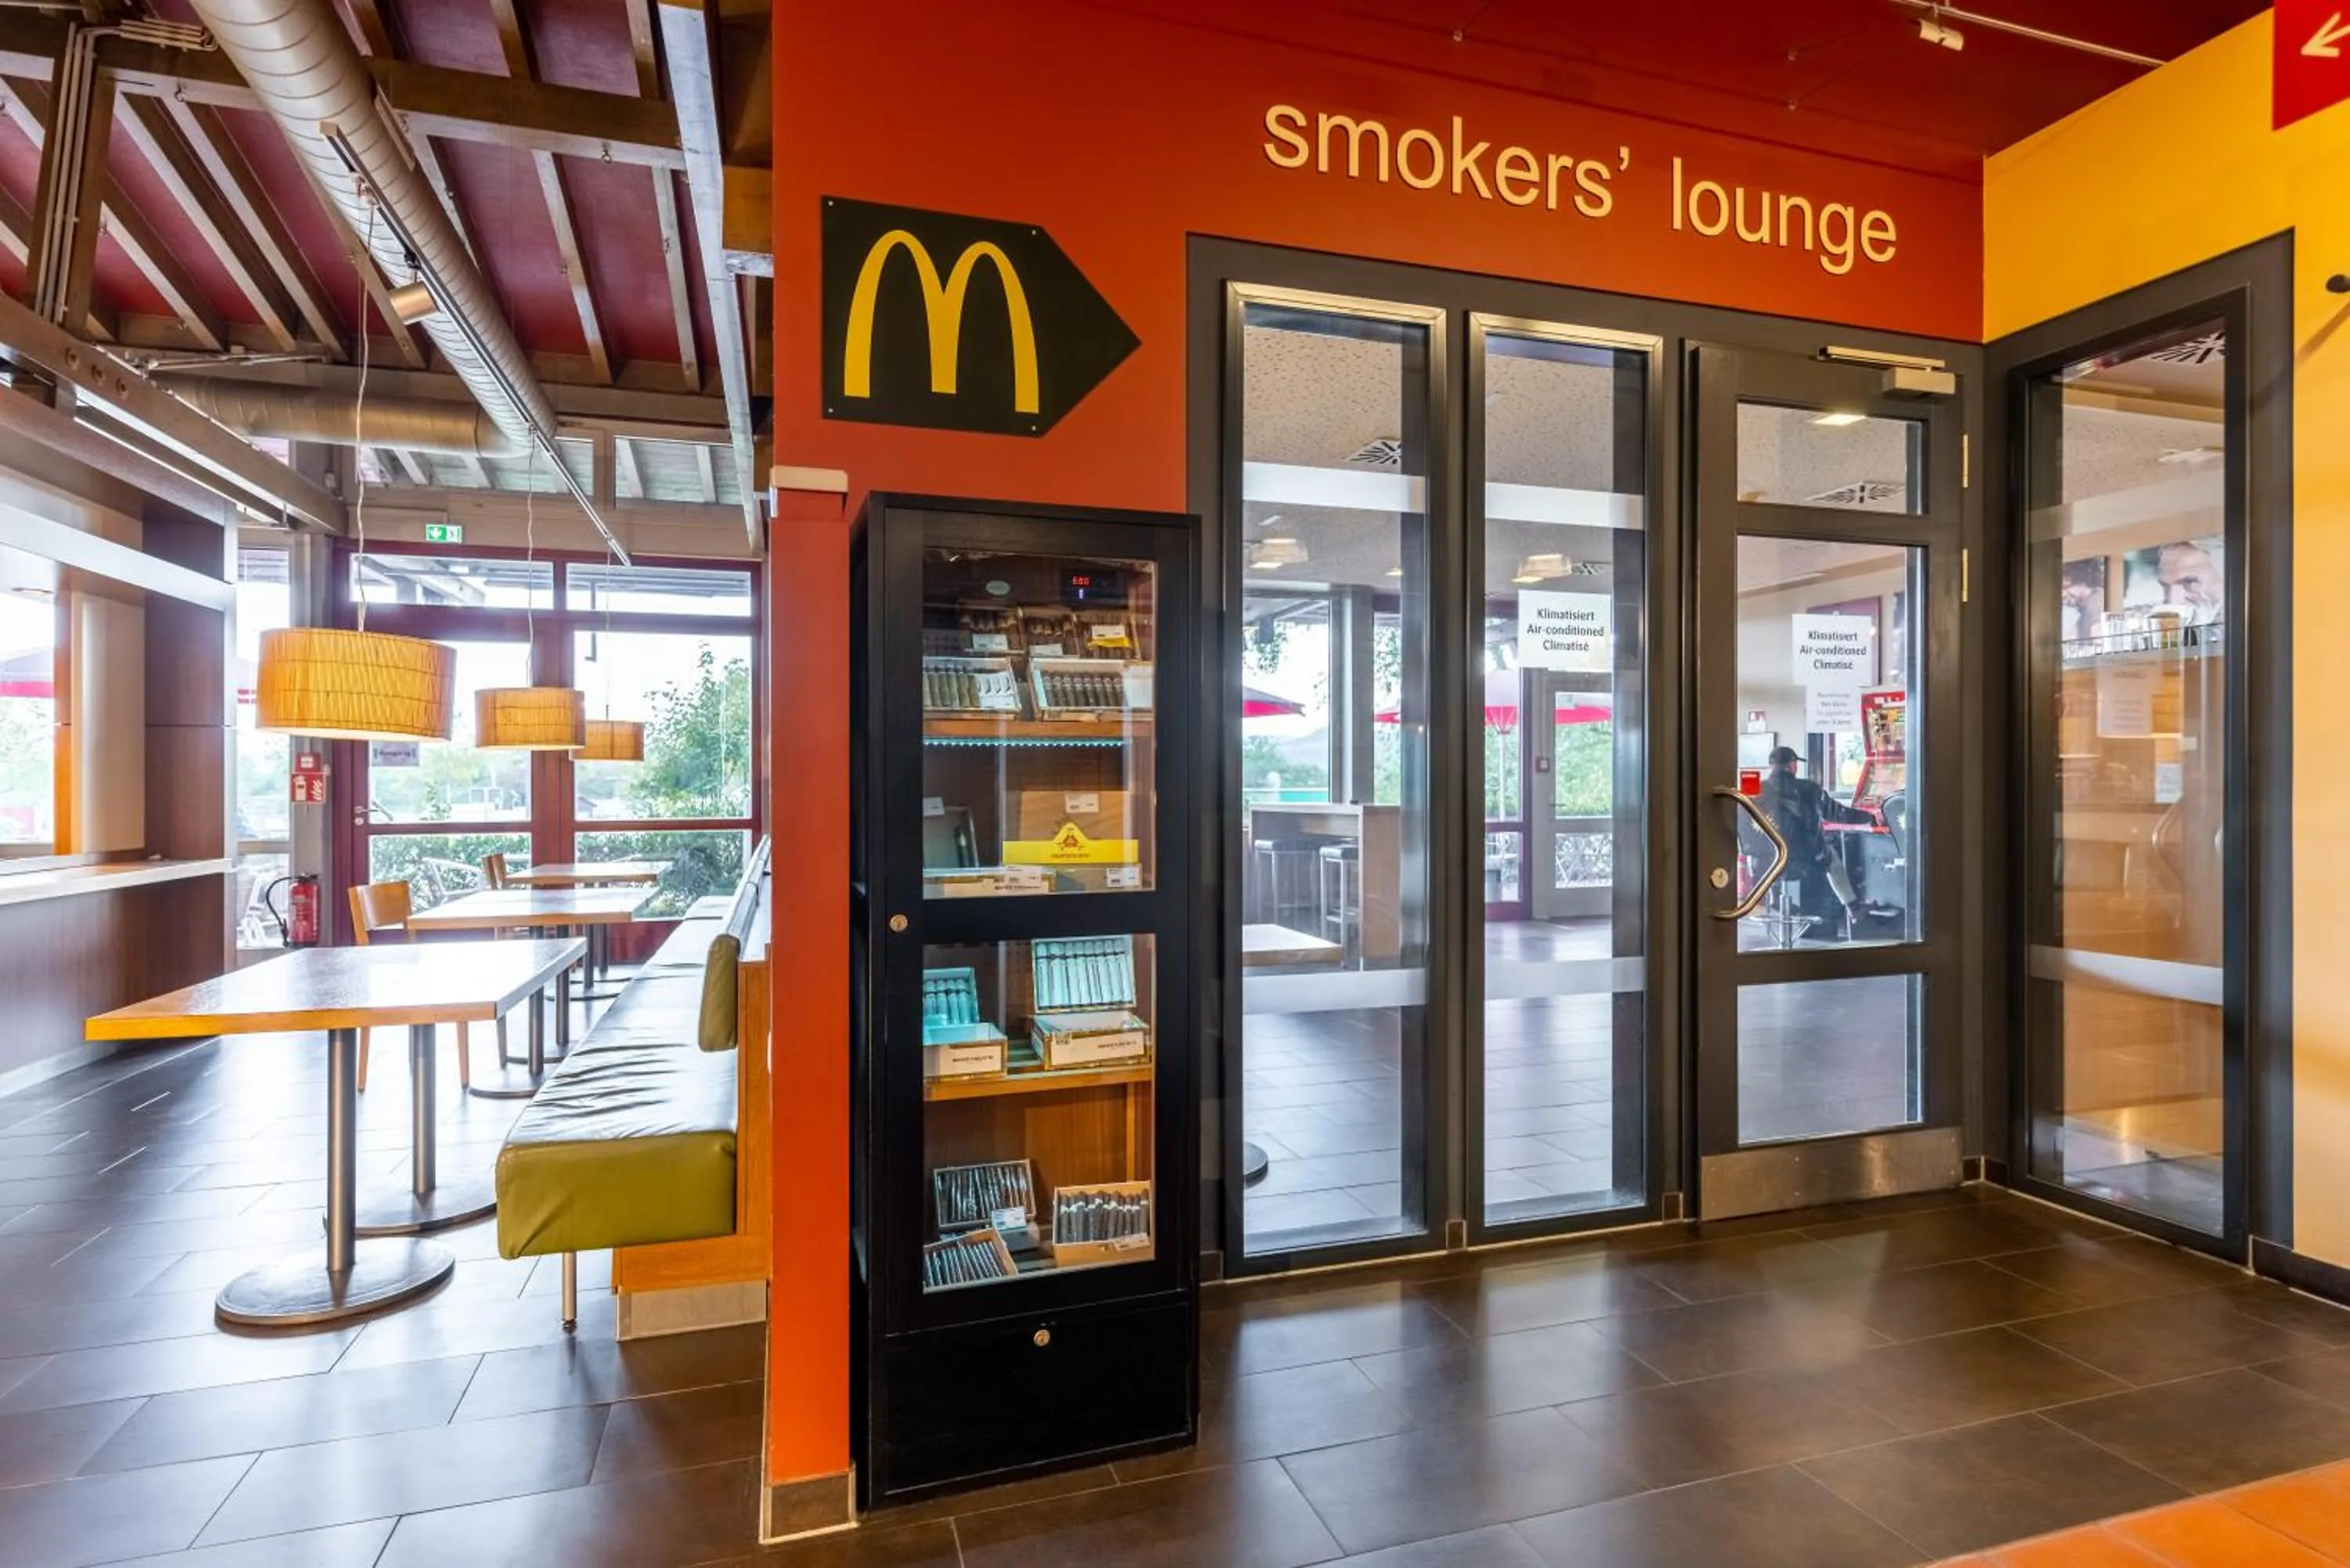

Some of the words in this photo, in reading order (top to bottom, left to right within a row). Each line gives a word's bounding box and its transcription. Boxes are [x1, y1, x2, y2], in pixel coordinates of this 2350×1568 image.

[1673, 157, 1896, 274] lounge
[1536, 607, 1595, 621] Klimatisiert
[1526, 624, 1605, 637] Air-conditioned
[1807, 630, 1858, 641] Klimatisiert
[1542, 640, 1590, 652] Climatisé
[1799, 645, 1867, 656] Air-conditioned
[1813, 659, 1854, 670] Climatisé
